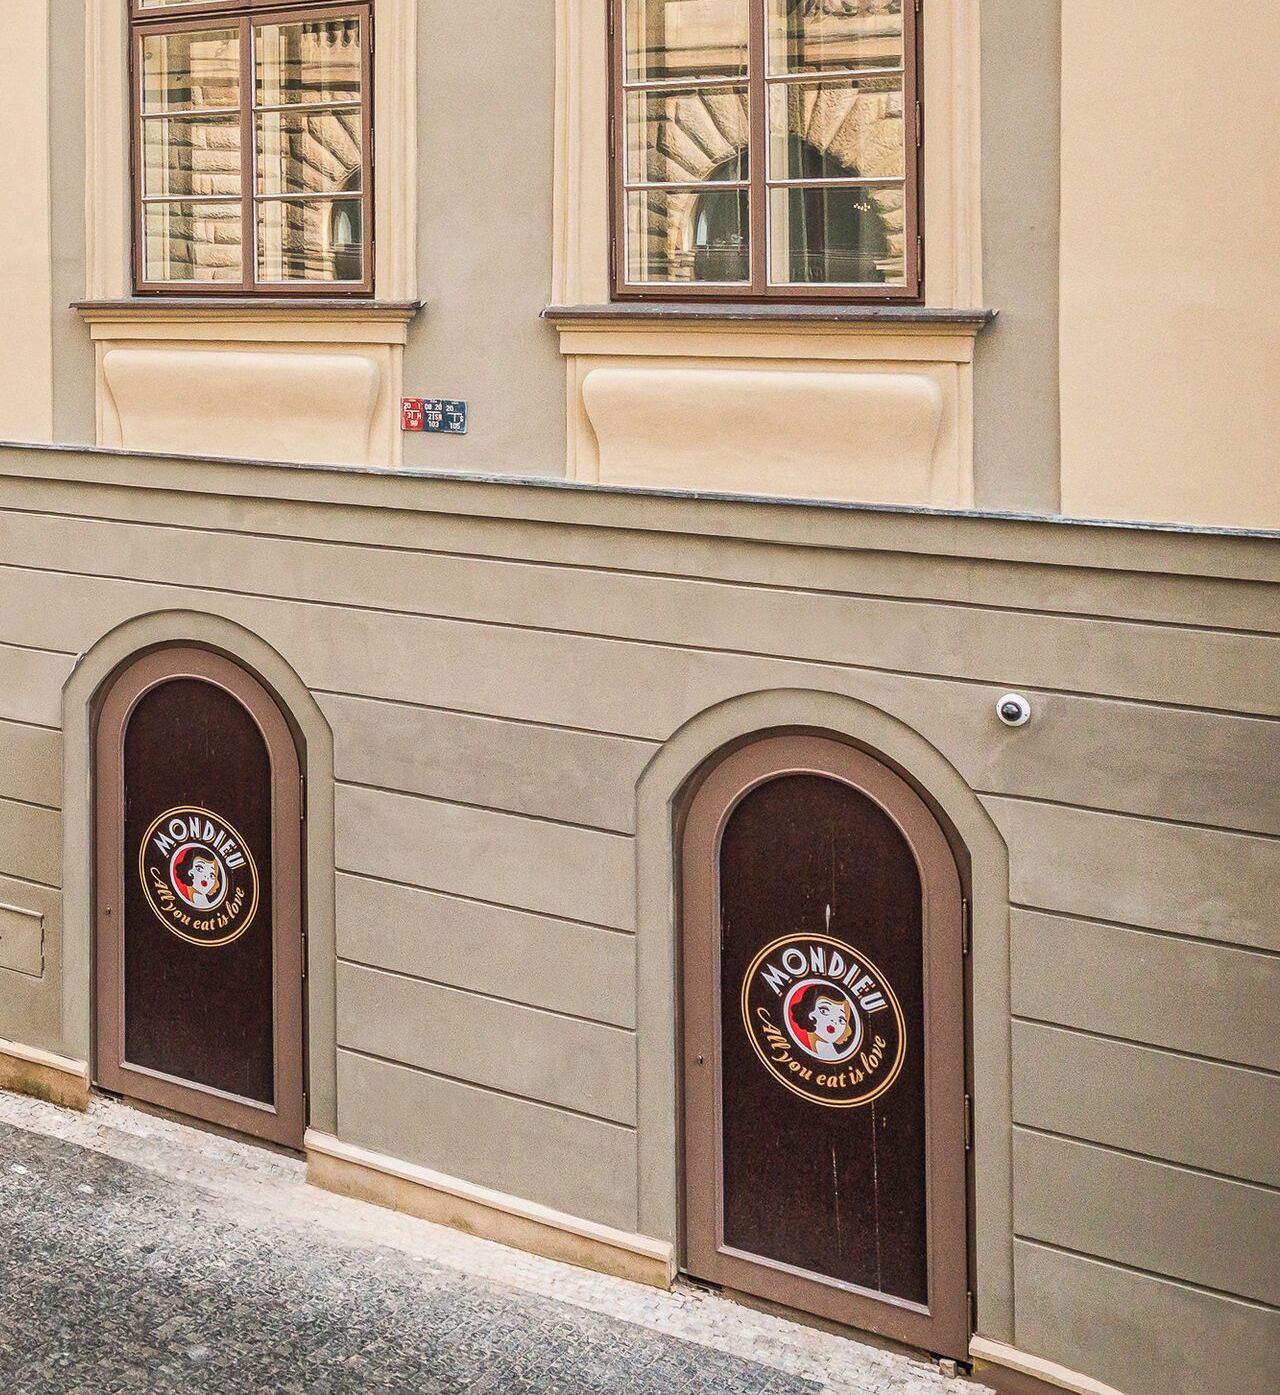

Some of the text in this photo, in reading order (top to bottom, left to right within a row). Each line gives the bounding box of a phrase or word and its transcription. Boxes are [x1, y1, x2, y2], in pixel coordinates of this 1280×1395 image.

[153, 816, 246, 870] MONDIEU
[150, 866, 245, 931] All you eat is love
[760, 946, 888, 1014] MONDIEU
[756, 1007, 887, 1088] All you eat is love
